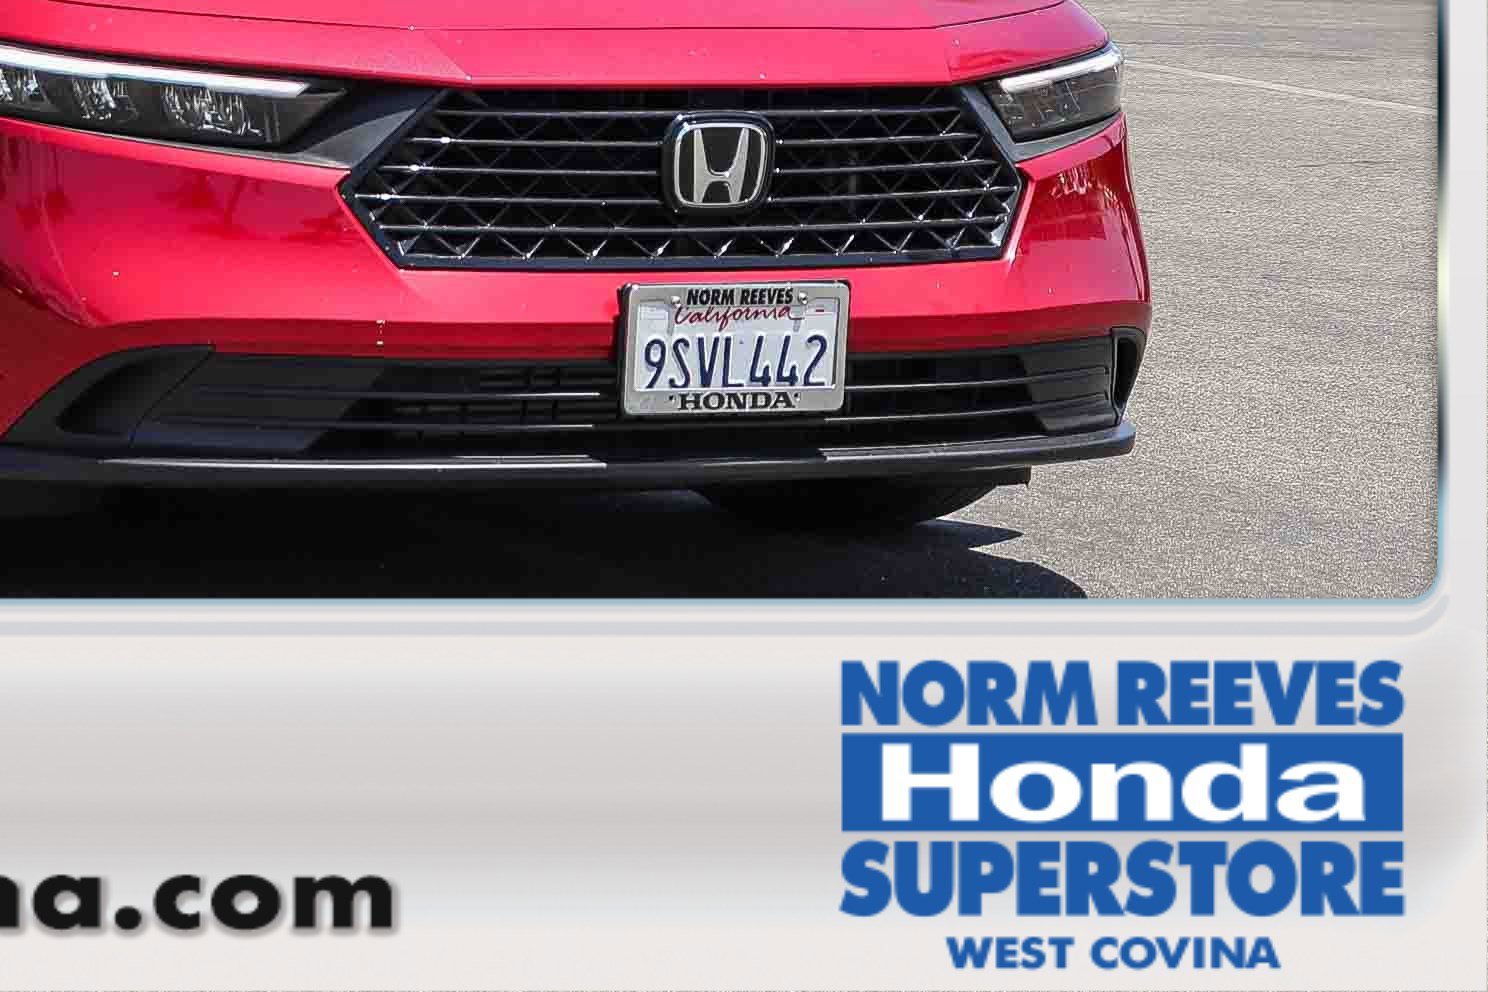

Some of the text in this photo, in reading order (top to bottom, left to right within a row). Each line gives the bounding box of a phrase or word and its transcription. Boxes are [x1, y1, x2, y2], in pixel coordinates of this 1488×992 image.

[686, 287, 794, 306] NORM REEVES
[673, 306, 805, 332] California
[644, 334, 828, 390] 9SVL442
[677, 391, 796, 411] HONDA
